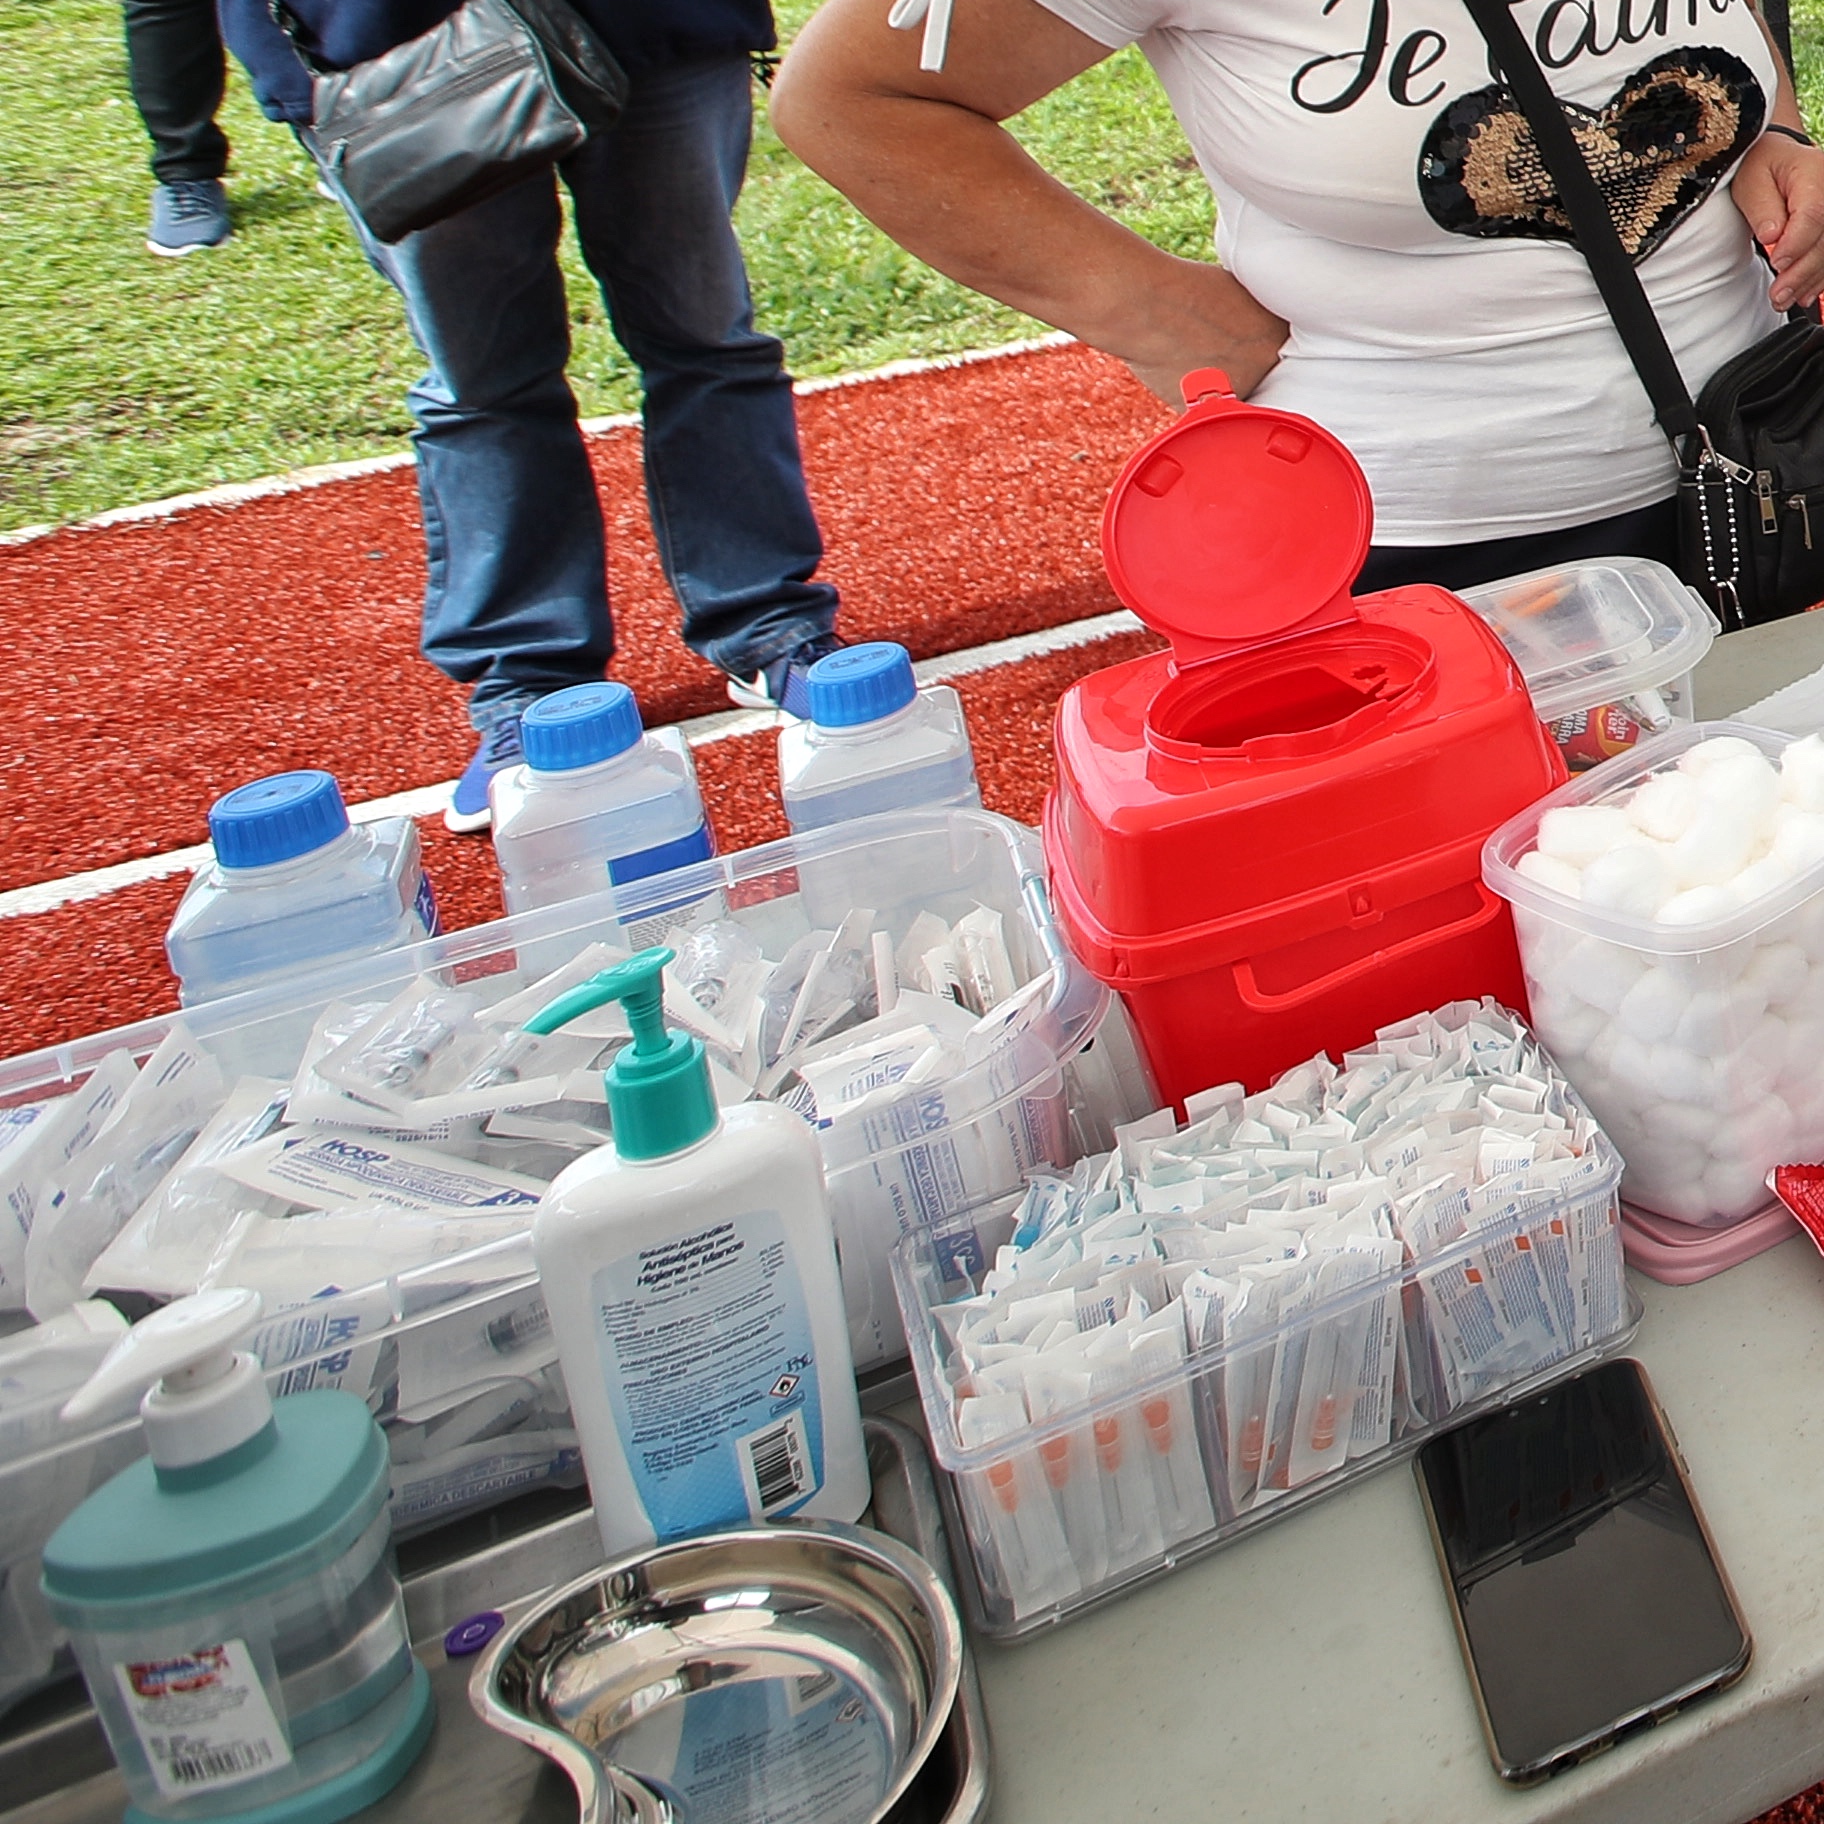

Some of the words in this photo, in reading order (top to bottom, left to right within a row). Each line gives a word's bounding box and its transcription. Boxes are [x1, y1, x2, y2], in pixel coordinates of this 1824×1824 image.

[320, 1138, 391, 1164] HOSP
[384, 1193, 415, 1210] SOLO
[639, 1243, 679, 1260] Solución
[679, 1222, 734, 1249] Alcohólica
[642, 1240, 715, 1273] Antiséptica
[637, 1262, 687, 1287] Higiene
[701, 1240, 745, 1266] Manos
[711, 1324, 771, 1355] HOSPITALARIO
